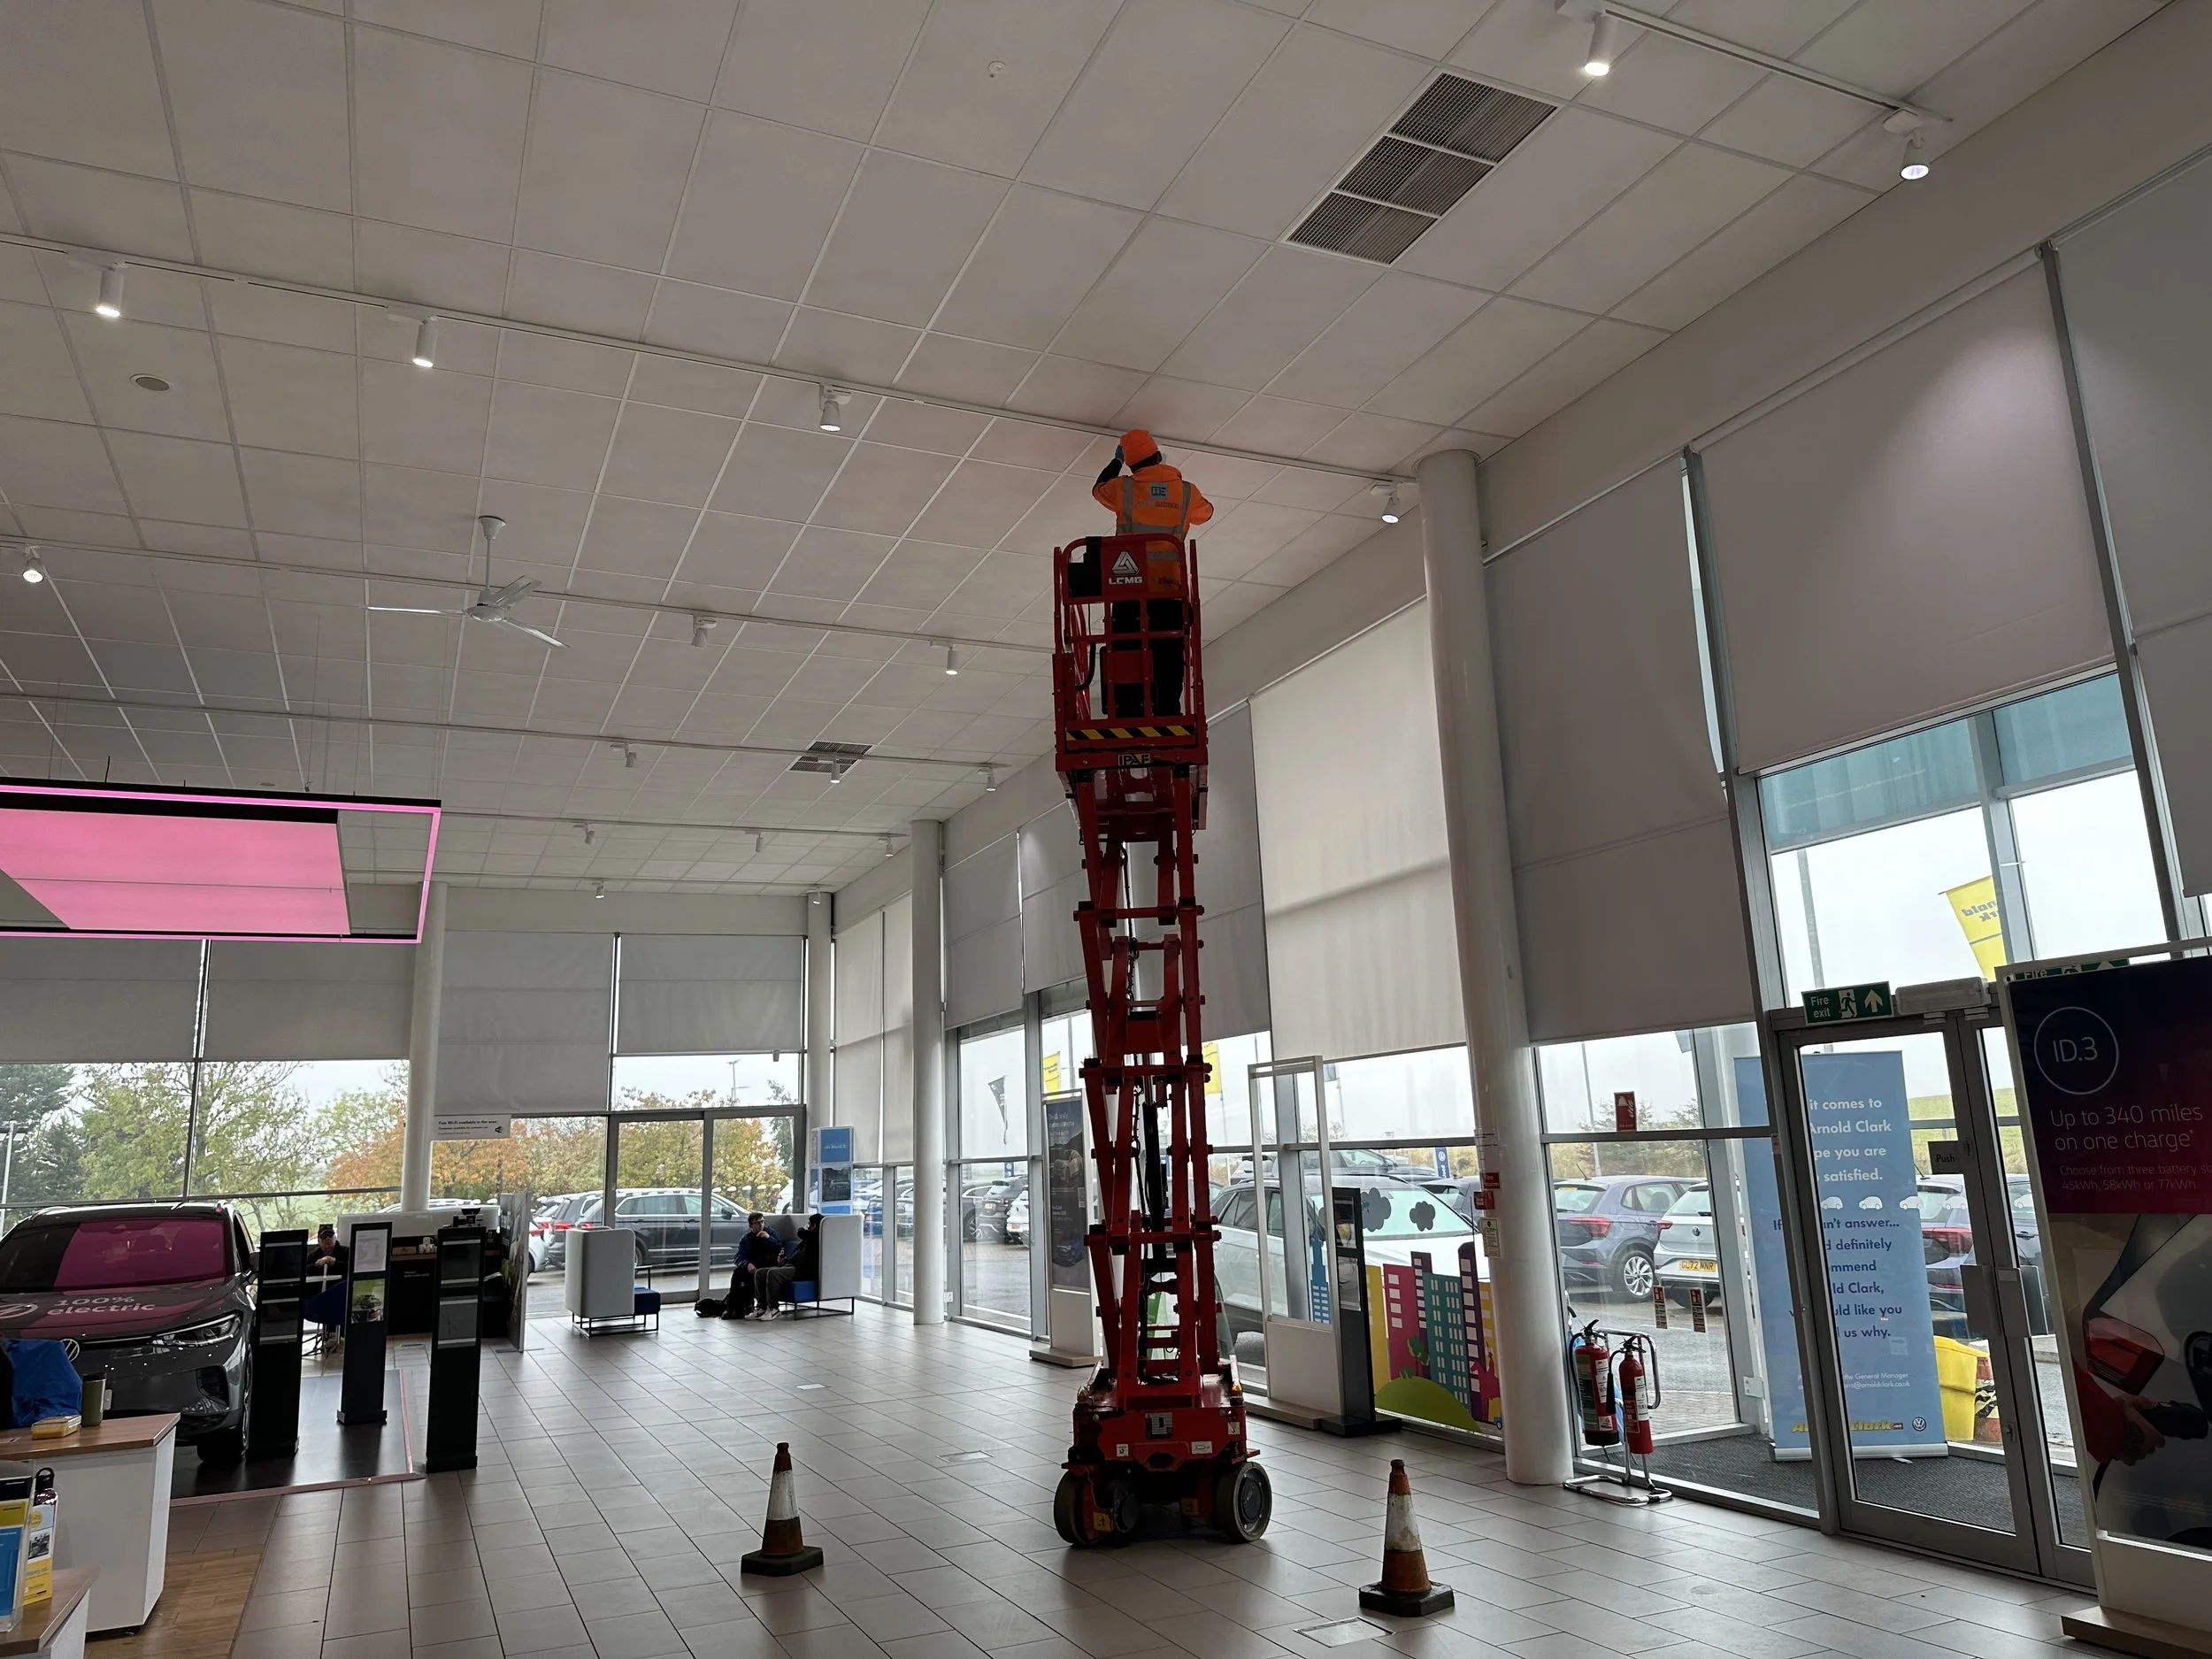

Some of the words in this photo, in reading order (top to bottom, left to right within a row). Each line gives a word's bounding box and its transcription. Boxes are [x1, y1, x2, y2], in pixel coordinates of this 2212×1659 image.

[1810, 996, 1830, 1006] Fire
[1813, 1008, 1831, 1018] exit
[2053, 1036, 2098, 1062] ID.3
[1809, 1099, 1818, 1110] it
[1823, 1101, 1865, 1110] comes
[1869, 1098, 1882, 1108] to
[2050, 1110, 2076, 1130] Up
[2081, 1110, 2099, 1125] to
[2104, 1105, 2144, 1125] 340
[2151, 1103, 2203, 1123] miles
[1855, 1119, 1892, 1132] Clark
[2055, 1137, 2078, 1150] on
[2084, 1135, 2118, 1150] one
[1814, 1149, 1831, 1161] pe
[1834, 1148, 1860, 1160] you
[1864, 1148, 1886, 1156] are
[1936, 1154, 1955, 1163] Push
[1824, 1168, 1883, 1182] satisfied.
[2060, 1165, 2097, 1176] Choose
[2100, 1164, 2124, 1175] from
[2127, 1164, 2154, 1175] three
[2158, 1164, 2197, 1177] battery
[1824, 1218, 1841, 1229] n't
[1845, 1219, 1900, 1228] answer...
[1836, 1238, 1892, 1252] definitely
[1700, 1261, 1714, 1270] NNR
[1831, 1260, 1877, 1272] mmend
[1848, 1281, 1885, 1294] Clark,
[55, 1296, 134, 1306] 100%
[47, 1302, 156, 1316] electric
[1855, 1304, 1876, 1316] like
[1879, 1306, 1902, 1317] you
[1844, 1330, 1857, 1339] us
[1861, 1325, 1891, 1340] why.
[1881, 1372, 1909, 1381] Manager
